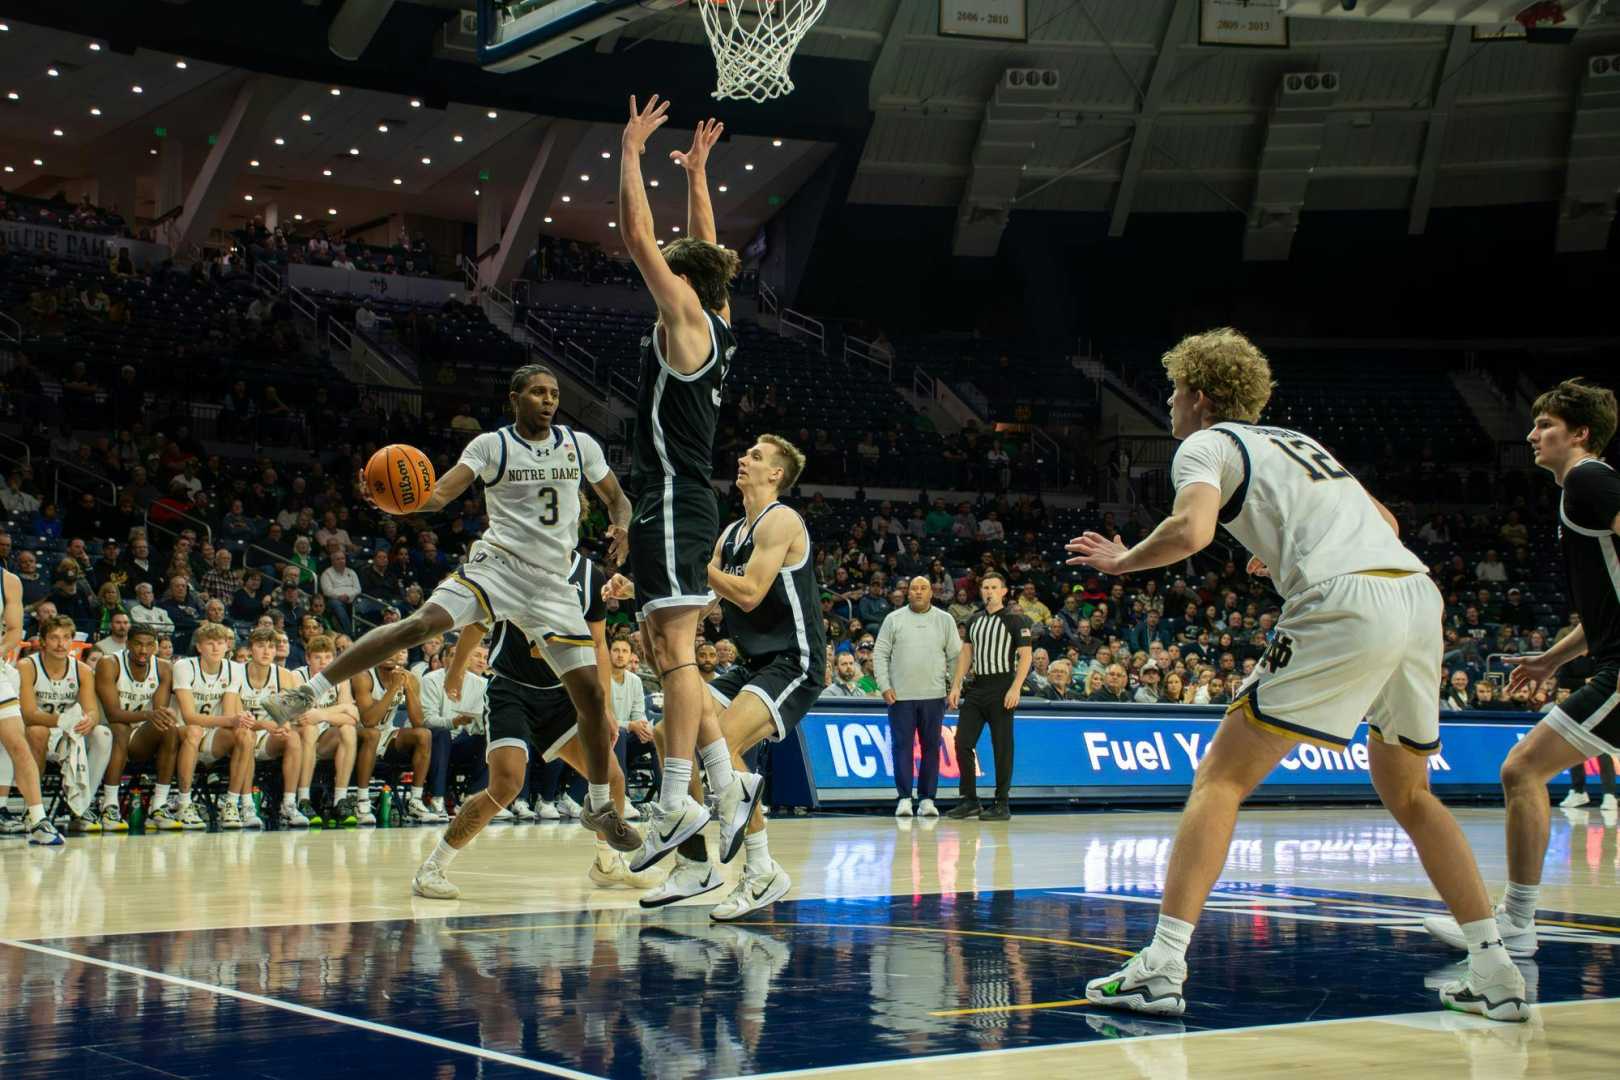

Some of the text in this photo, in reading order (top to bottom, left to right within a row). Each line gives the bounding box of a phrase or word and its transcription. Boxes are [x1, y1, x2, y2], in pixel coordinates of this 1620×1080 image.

[508, 467, 579, 482] NOTRE DAME
[1269, 437, 1350, 481] 12
[397, 459, 415, 504] Wilson
[537, 486, 559, 526] 3
[1083, 731, 1172, 771] Fuel
